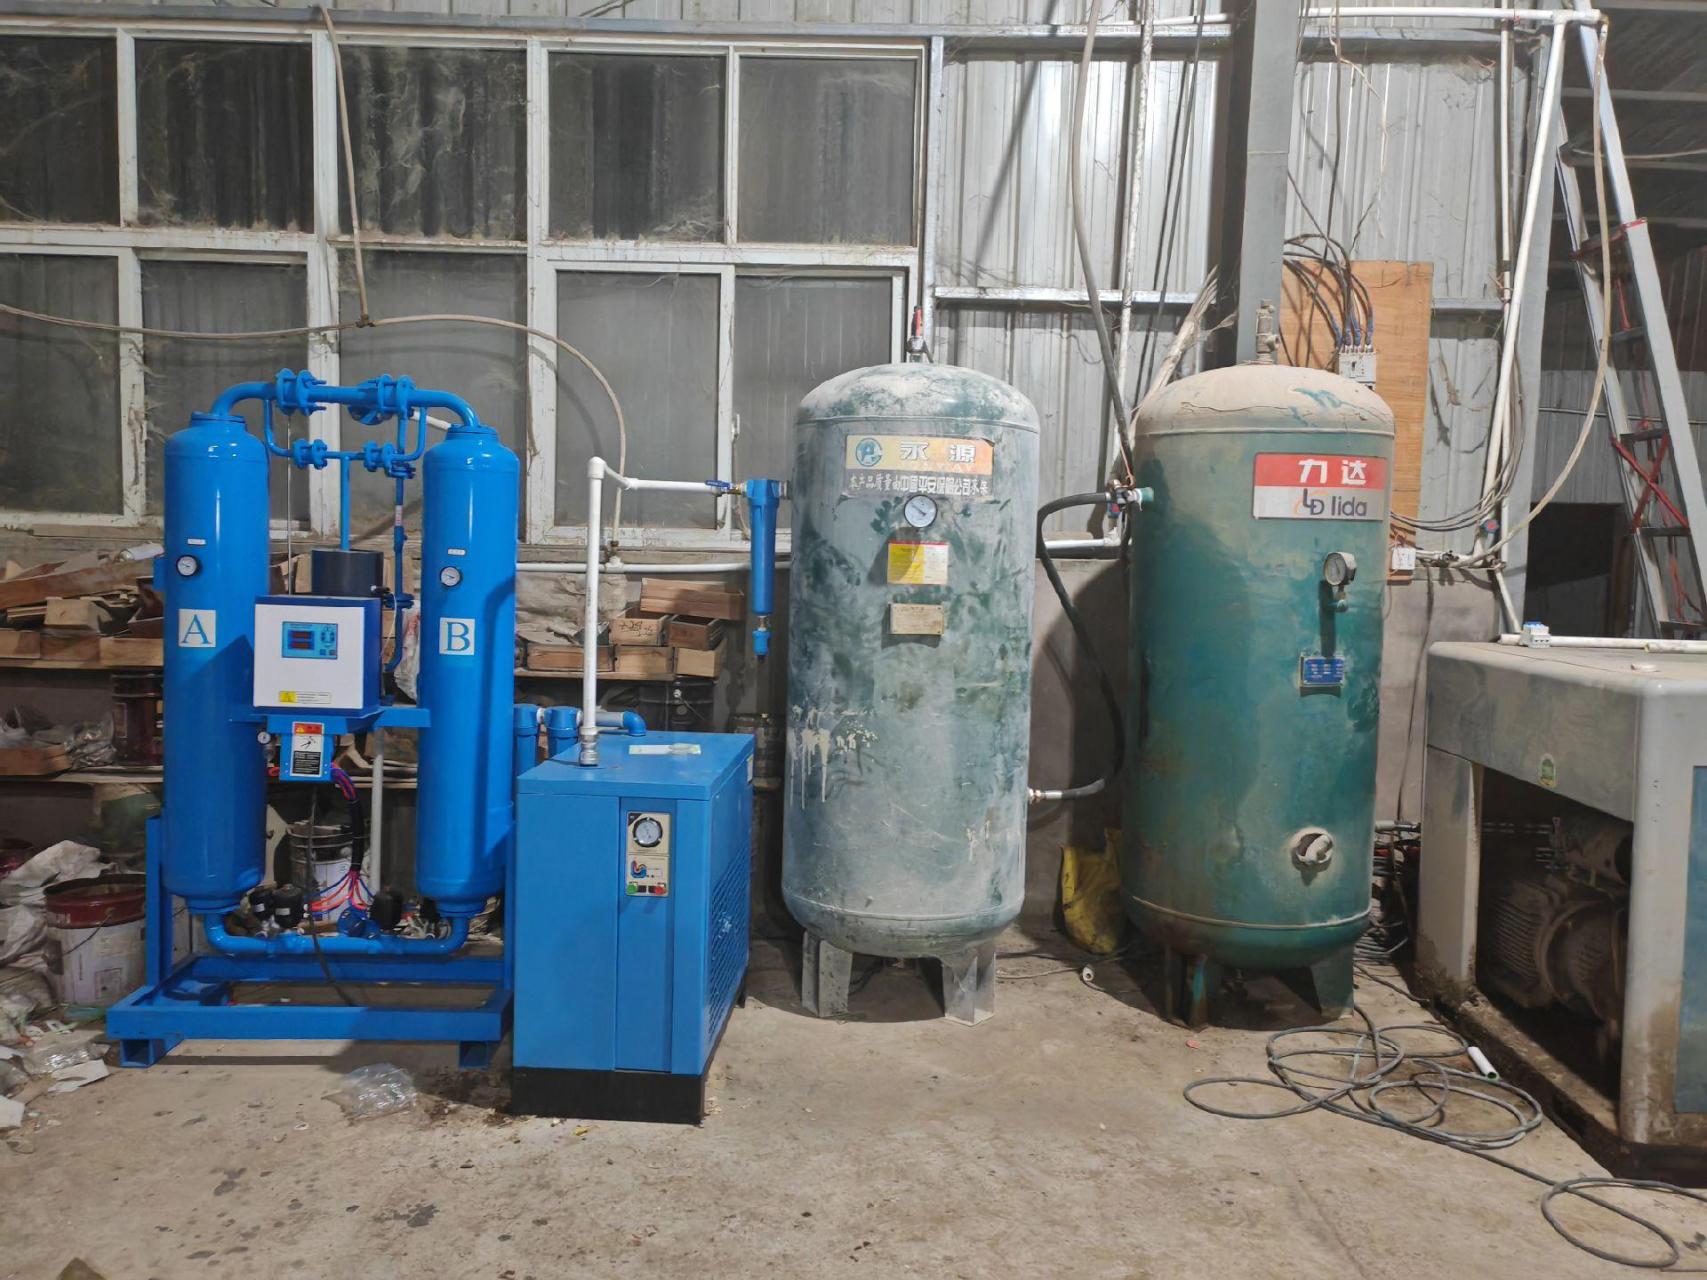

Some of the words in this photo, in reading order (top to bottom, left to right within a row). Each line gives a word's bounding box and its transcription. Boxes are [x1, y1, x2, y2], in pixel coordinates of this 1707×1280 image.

[900, 441, 976, 464] 永源
[1298, 458, 1367, 485] 力达
[1331, 495, 1367, 516] lida
[180, 614, 213, 644] A
[444, 621, 471, 651] B
